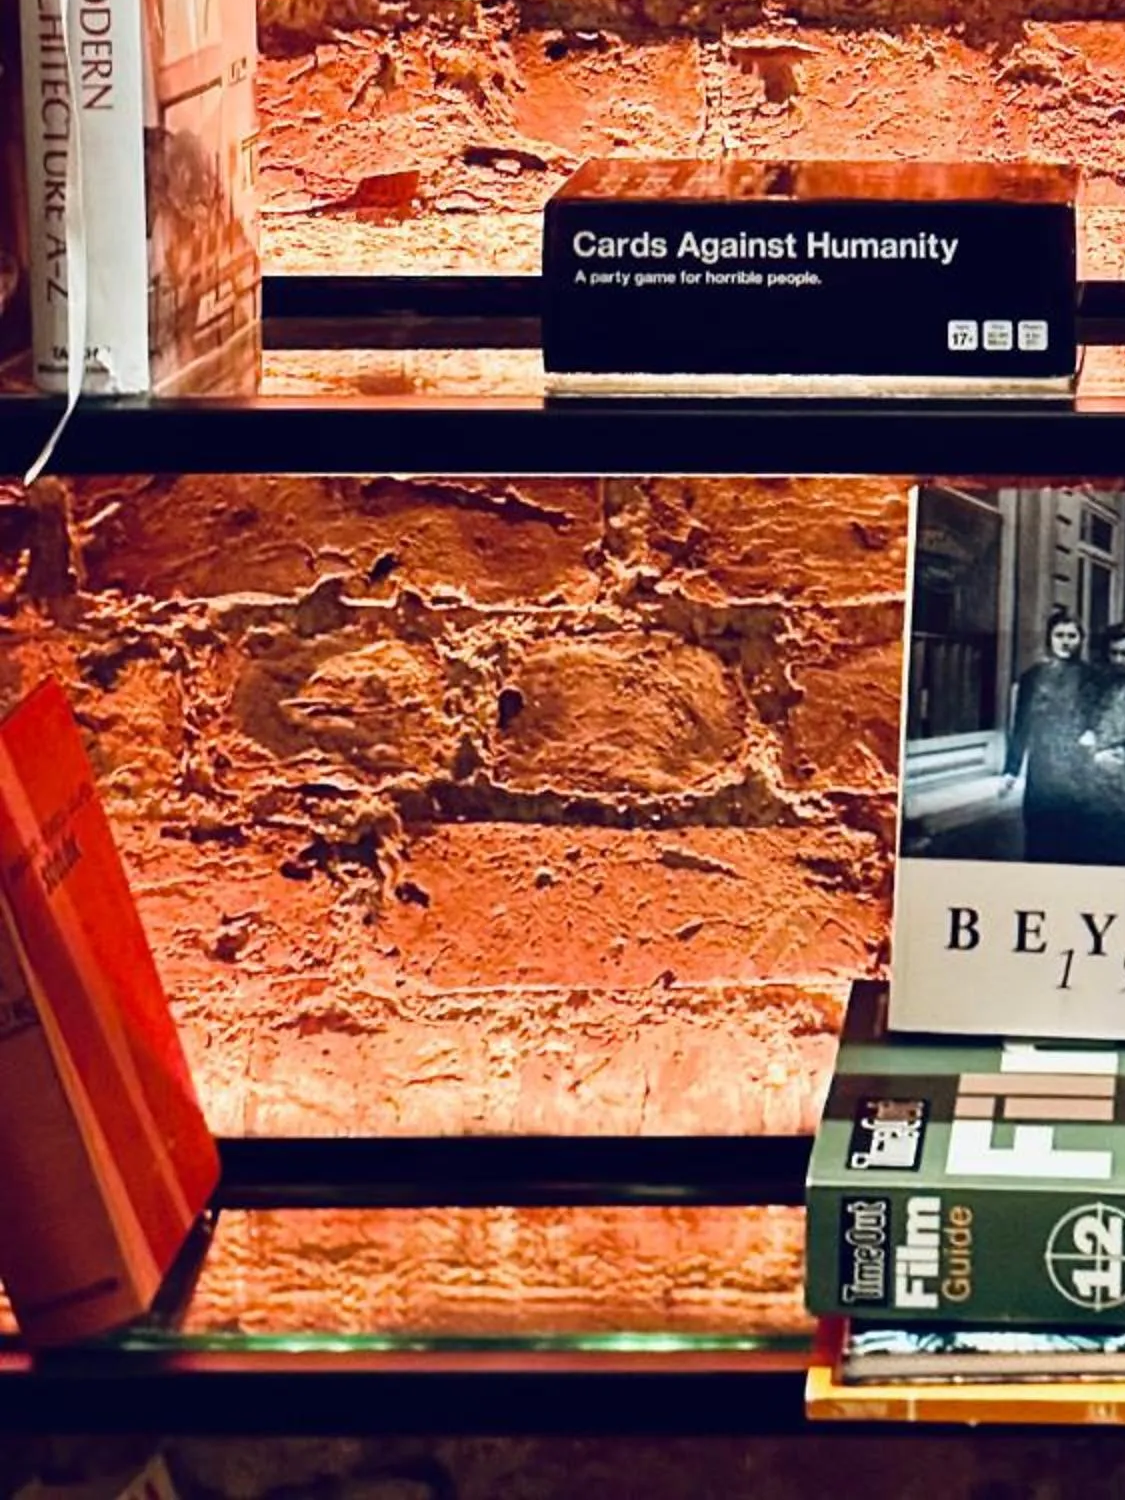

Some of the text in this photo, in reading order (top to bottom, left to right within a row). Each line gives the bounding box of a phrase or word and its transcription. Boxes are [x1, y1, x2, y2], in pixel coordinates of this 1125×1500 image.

[573, 230, 959, 265] Cards Against Humanity
[574, 270, 822, 287] A party game for horrible people.
[894, 1196, 941, 1309] Film
[942, 1205, 973, 1303] Guide
[1071, 1214, 1124, 1297] 12
